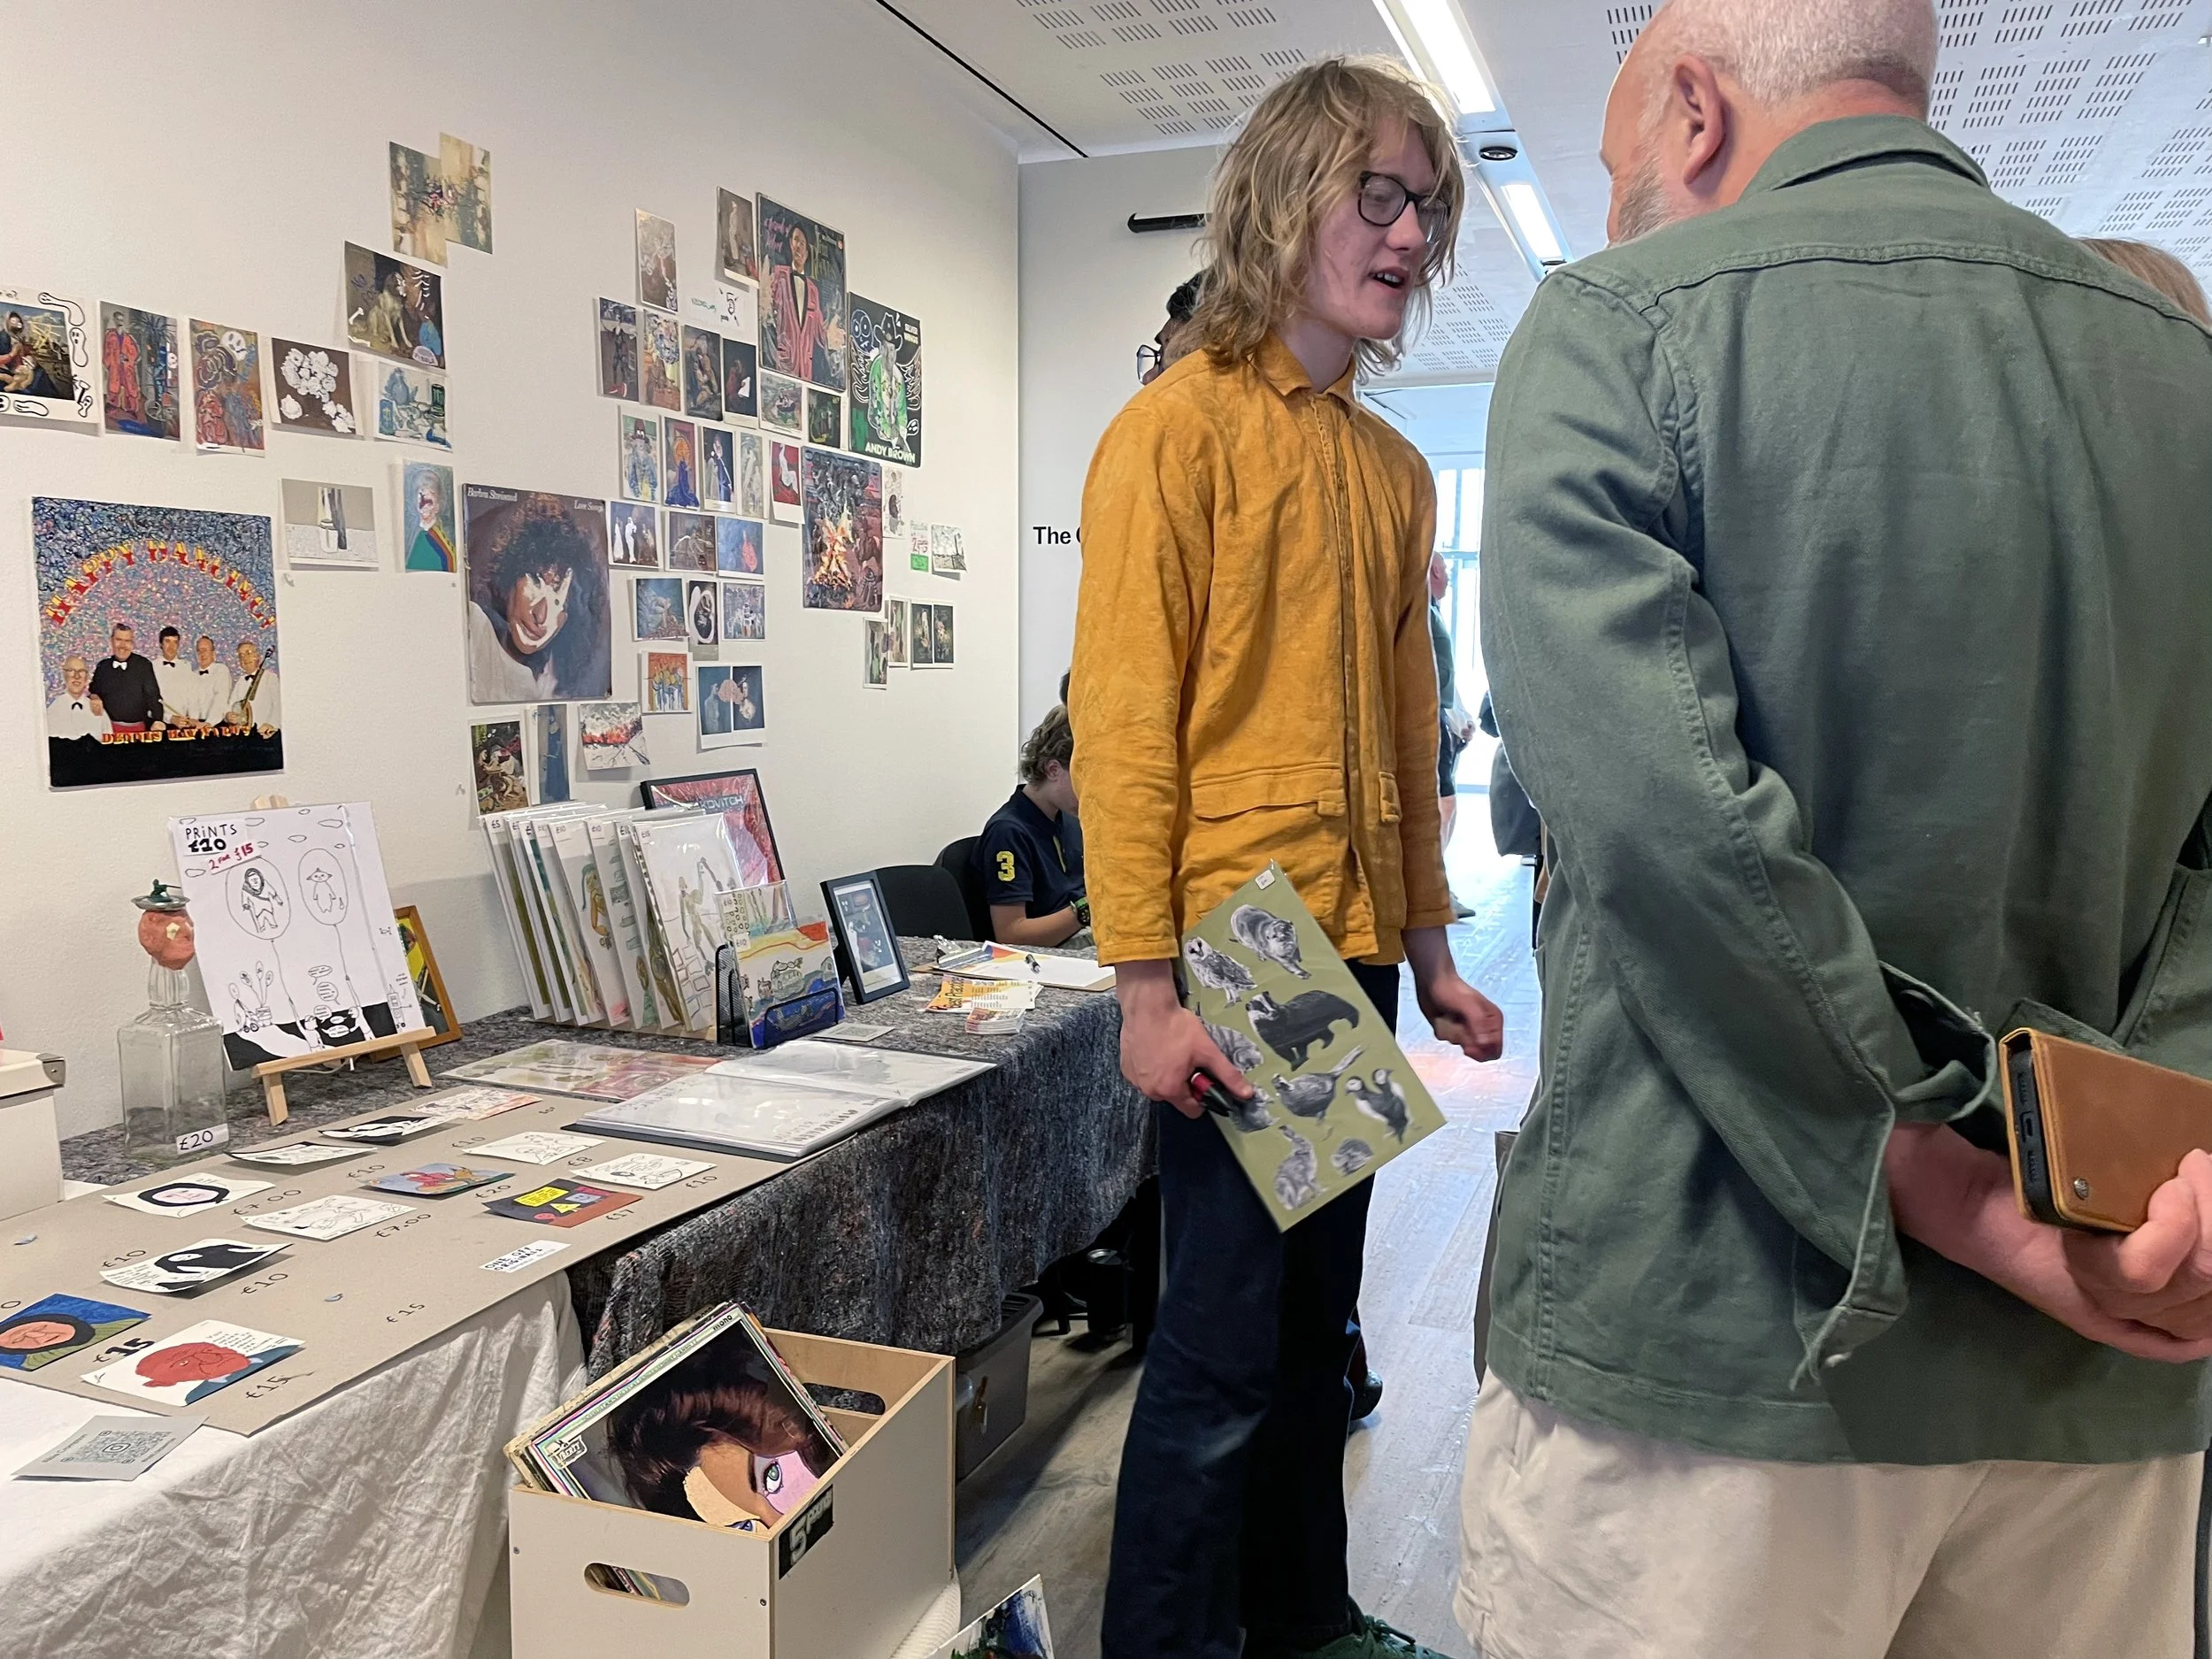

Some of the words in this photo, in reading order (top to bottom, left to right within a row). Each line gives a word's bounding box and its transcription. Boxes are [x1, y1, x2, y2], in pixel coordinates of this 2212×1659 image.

[865, 442, 887, 456] ANDY
[887, 446, 916, 463] BROWN
[1033, 526, 1071, 544] The
[45, 539, 135, 626] HAPPY
[701, 795, 744, 810] KOVITCH
[188, 838, 227, 853] £10
[208, 859, 219, 871] 2
[234, 842, 254, 862] £15
[996, 850, 1015, 881] 3
[179, 1130, 214, 1150] £20
[451, 1136, 486, 1148] £10
[347, 1164, 386, 1179] £10
[567, 1156, 593, 1167] £8
[474, 1184, 511, 1199] £20
[685, 1175, 718, 1189] £10
[374, 1213, 432, 1238] £7.00
[102, 1249, 147, 1269] £10
[484, 1255, 511, 1270] ONE
[511, 1246, 532, 1257] OFF
[240, 1272, 288, 1295] £10
[386, 1303, 425, 1323] £15
[712, 1315, 733, 1330] mono
[93, 1337, 156, 1363] £15
[789, 1515, 807, 1565] 5
